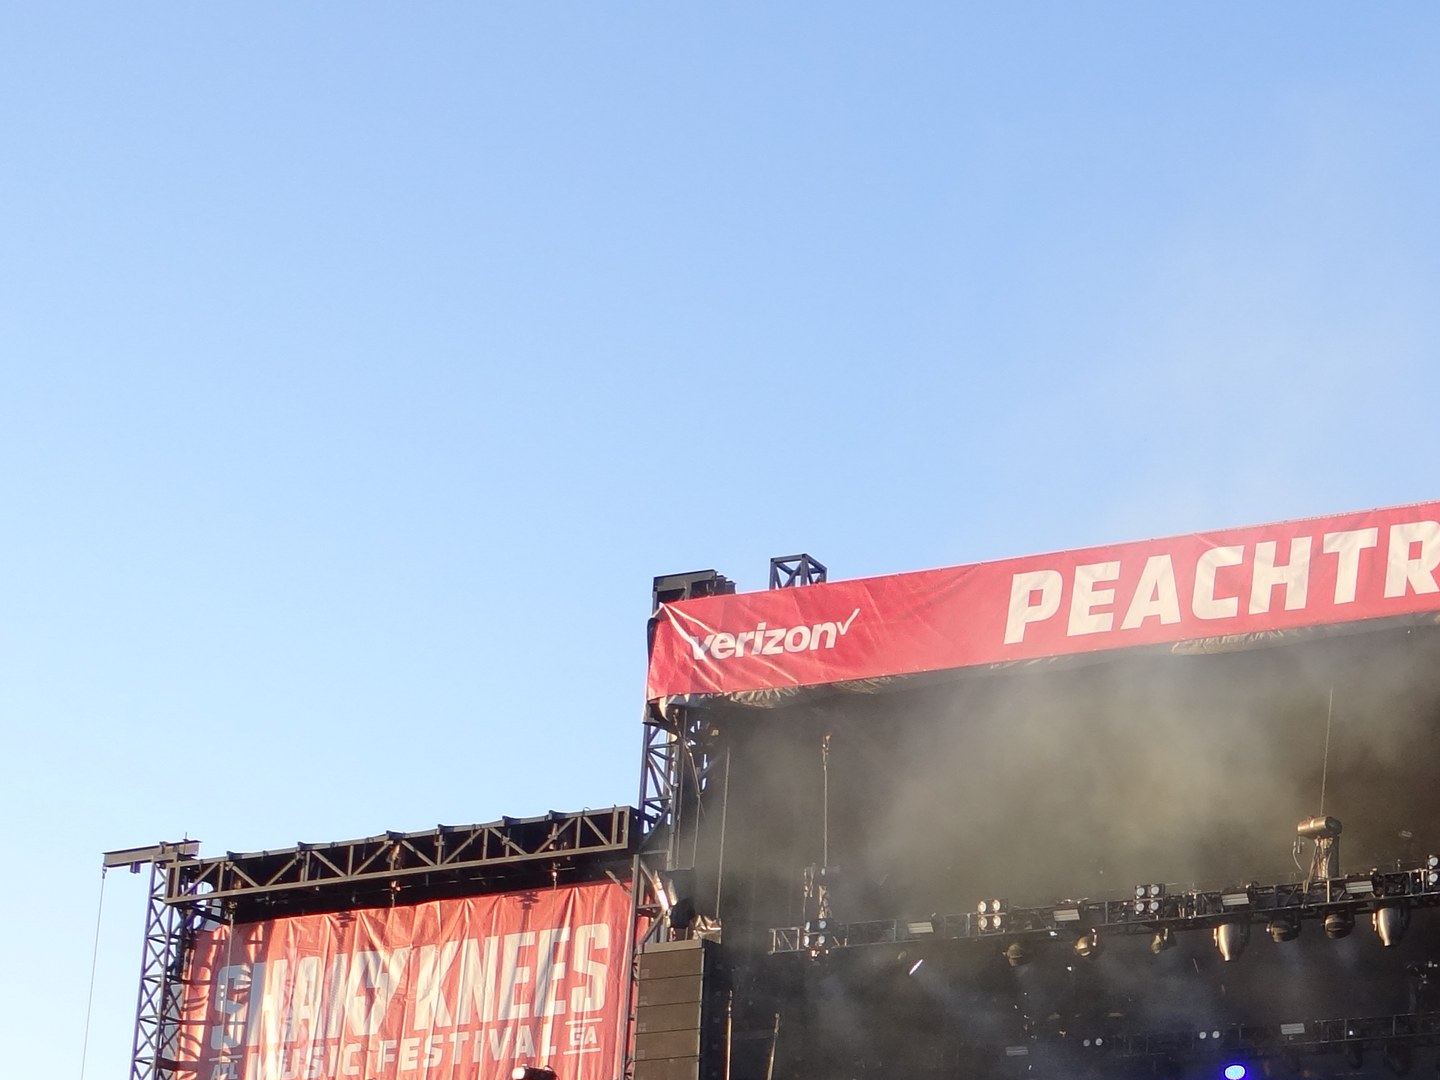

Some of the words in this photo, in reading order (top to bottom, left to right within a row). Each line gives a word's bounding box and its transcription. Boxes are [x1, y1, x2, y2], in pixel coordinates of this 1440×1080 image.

[689, 621, 837, 661] verizon
[210, 946, 411, 1051] SHAKY
[413, 922, 611, 1030] KNEES
[376, 1022, 557, 1073] FESTIVAL
[569, 1026, 599, 1046] GA
